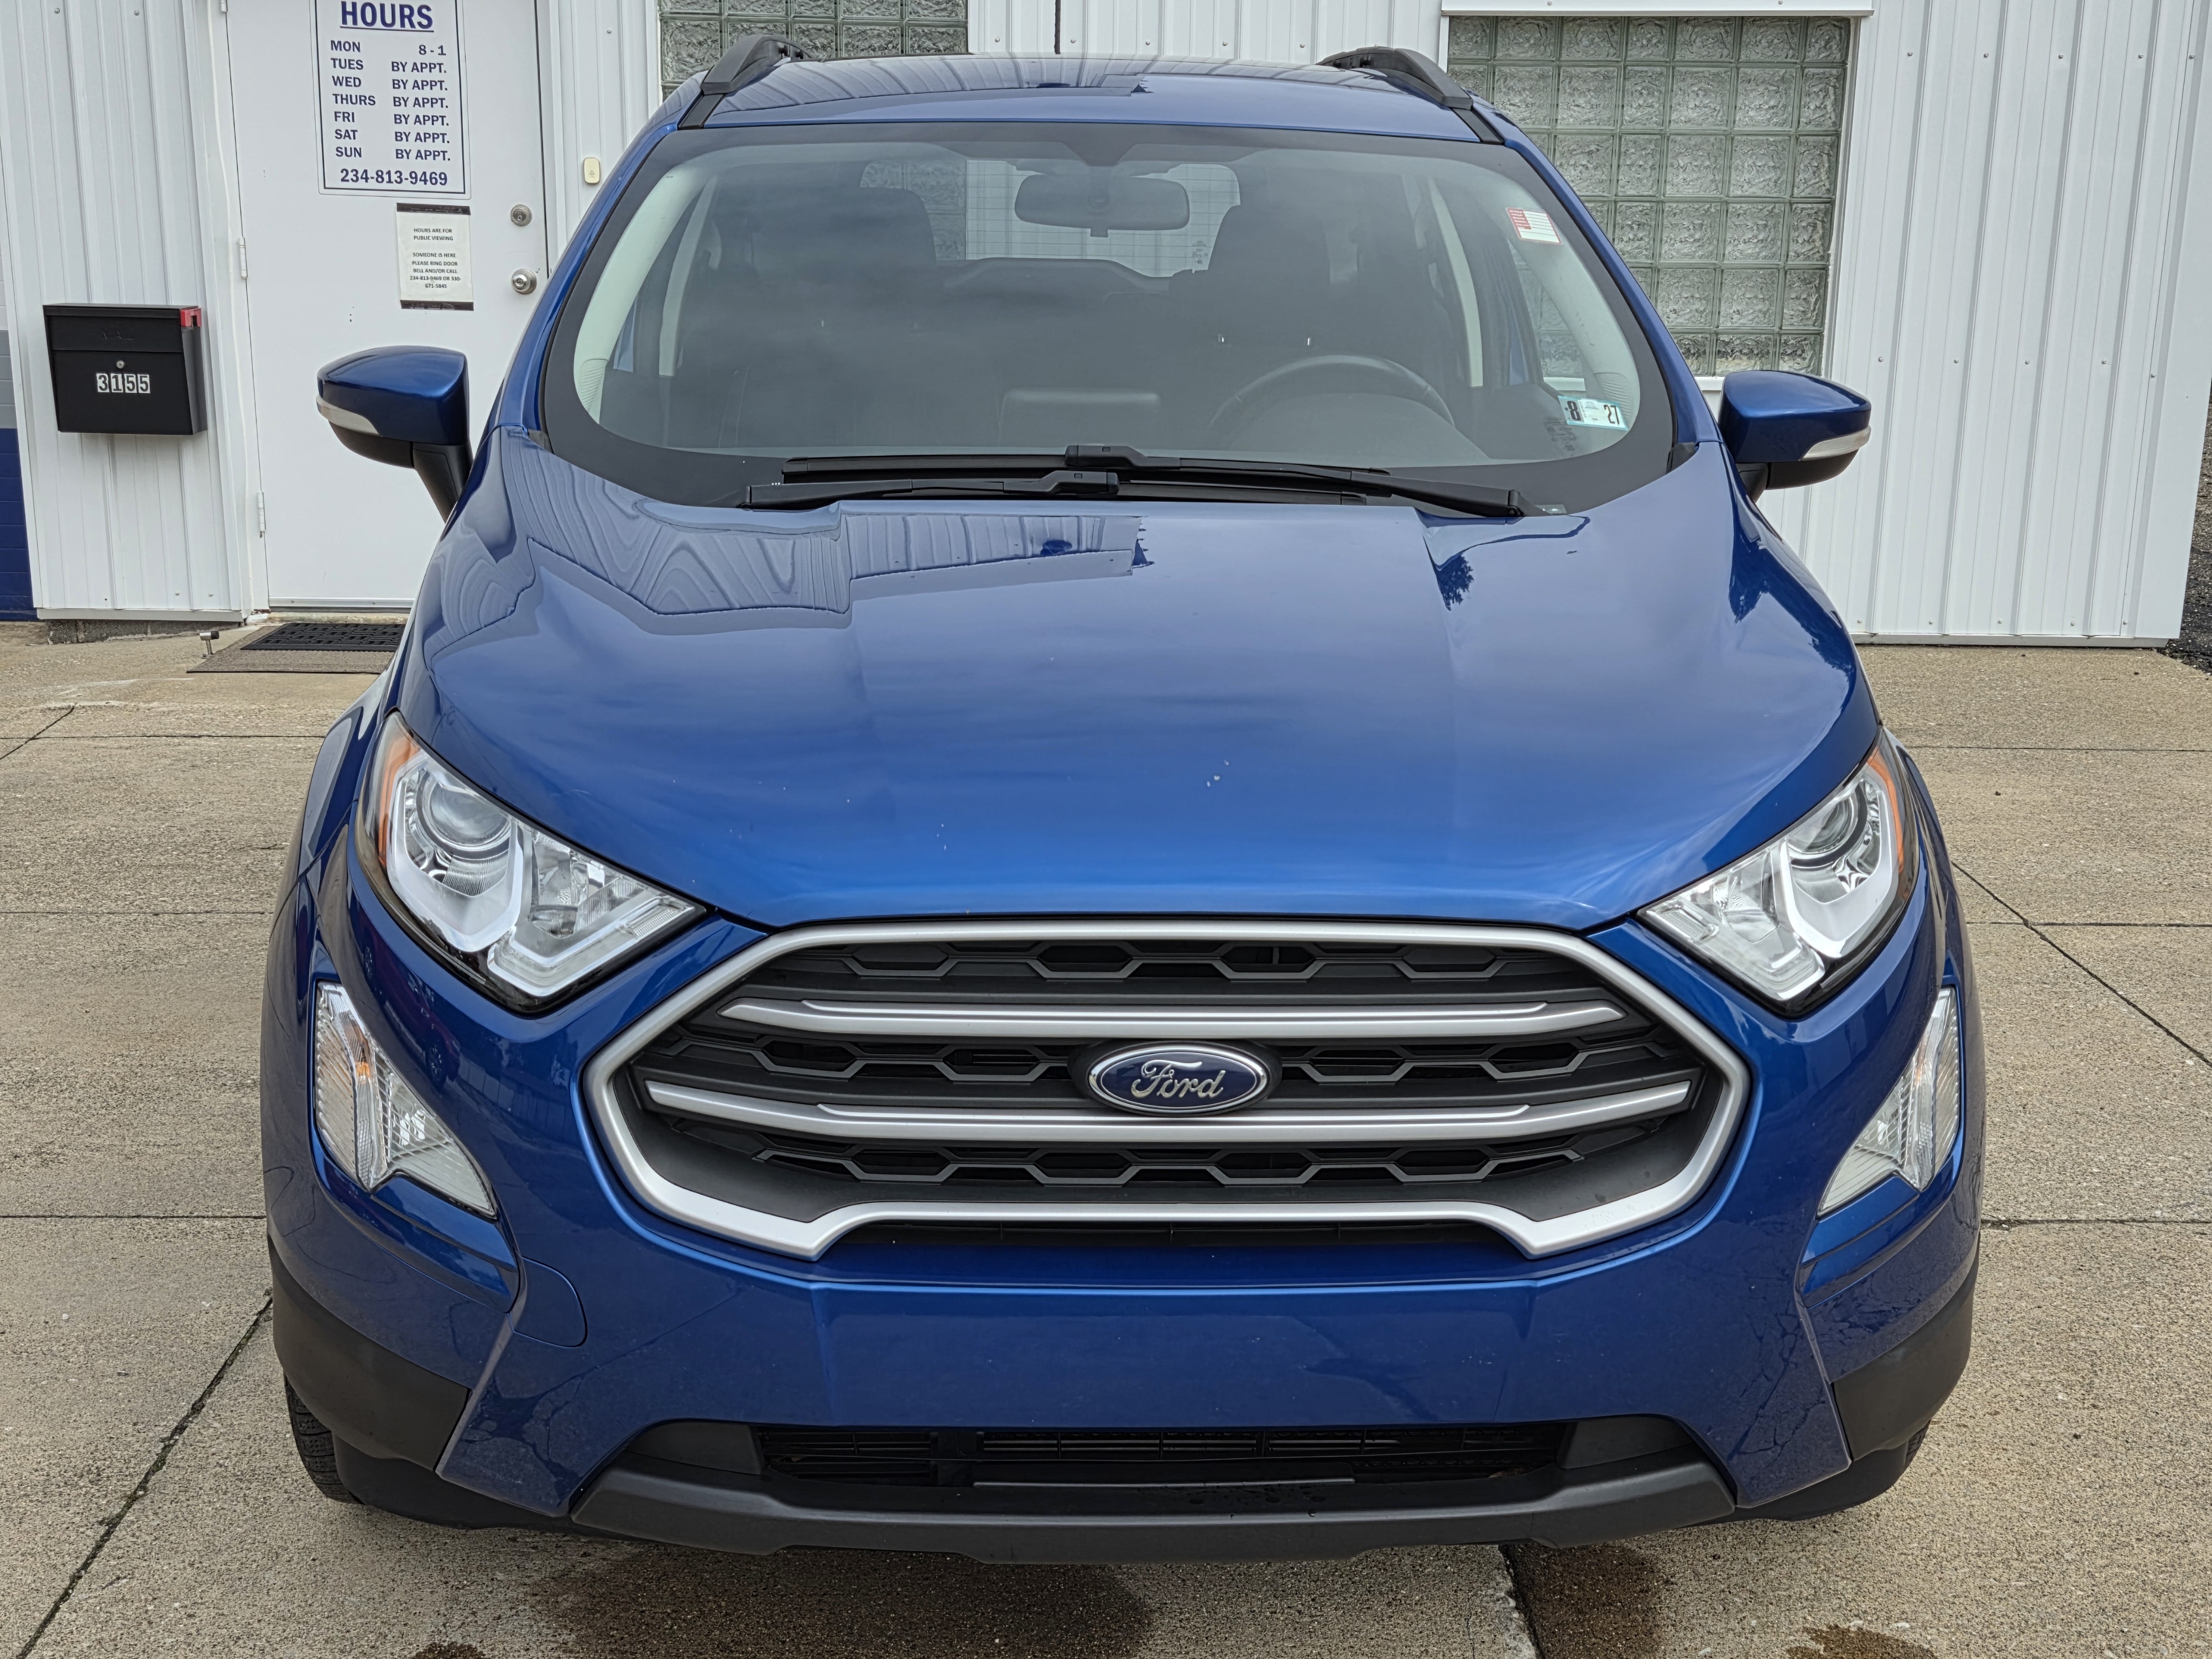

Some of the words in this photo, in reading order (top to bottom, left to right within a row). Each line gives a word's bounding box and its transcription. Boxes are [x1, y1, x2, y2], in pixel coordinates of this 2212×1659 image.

[341, 1, 433, 29] HOURS
[331, 40, 361, 53] MON
[419, 45, 427, 55] 8
[438, 45, 446, 55] 1
[331, 58, 363, 70] TUES
[391, 61, 408, 72] BY
[411, 62, 447, 73] APPT.
[332, 76, 362, 87] WED
[392, 79, 408, 90] BY
[412, 80, 447, 91] APPT.
[332, 93, 376, 106] THURS
[393, 96, 409, 107] BY
[413, 97, 448, 108] APPT.
[334, 111, 355, 122] FRI
[394, 114, 410, 124] BY
[414, 115, 449, 126] APPT.
[335, 129, 358, 140] SAT
[395, 131, 411, 142] BY
[414, 132, 450, 143] APPT.
[336, 147, 362, 158] SUN
[395, 149, 411, 159] BY
[415, 150, 451, 161] APPT.
[340, 168, 447, 186] 234-813-9469
[98, 374, 149, 392] 3155
[1567, 400, 1581, 421] 8
[1603, 404, 1620, 425] 27
[1131, 1059, 1227, 1099] Ford
